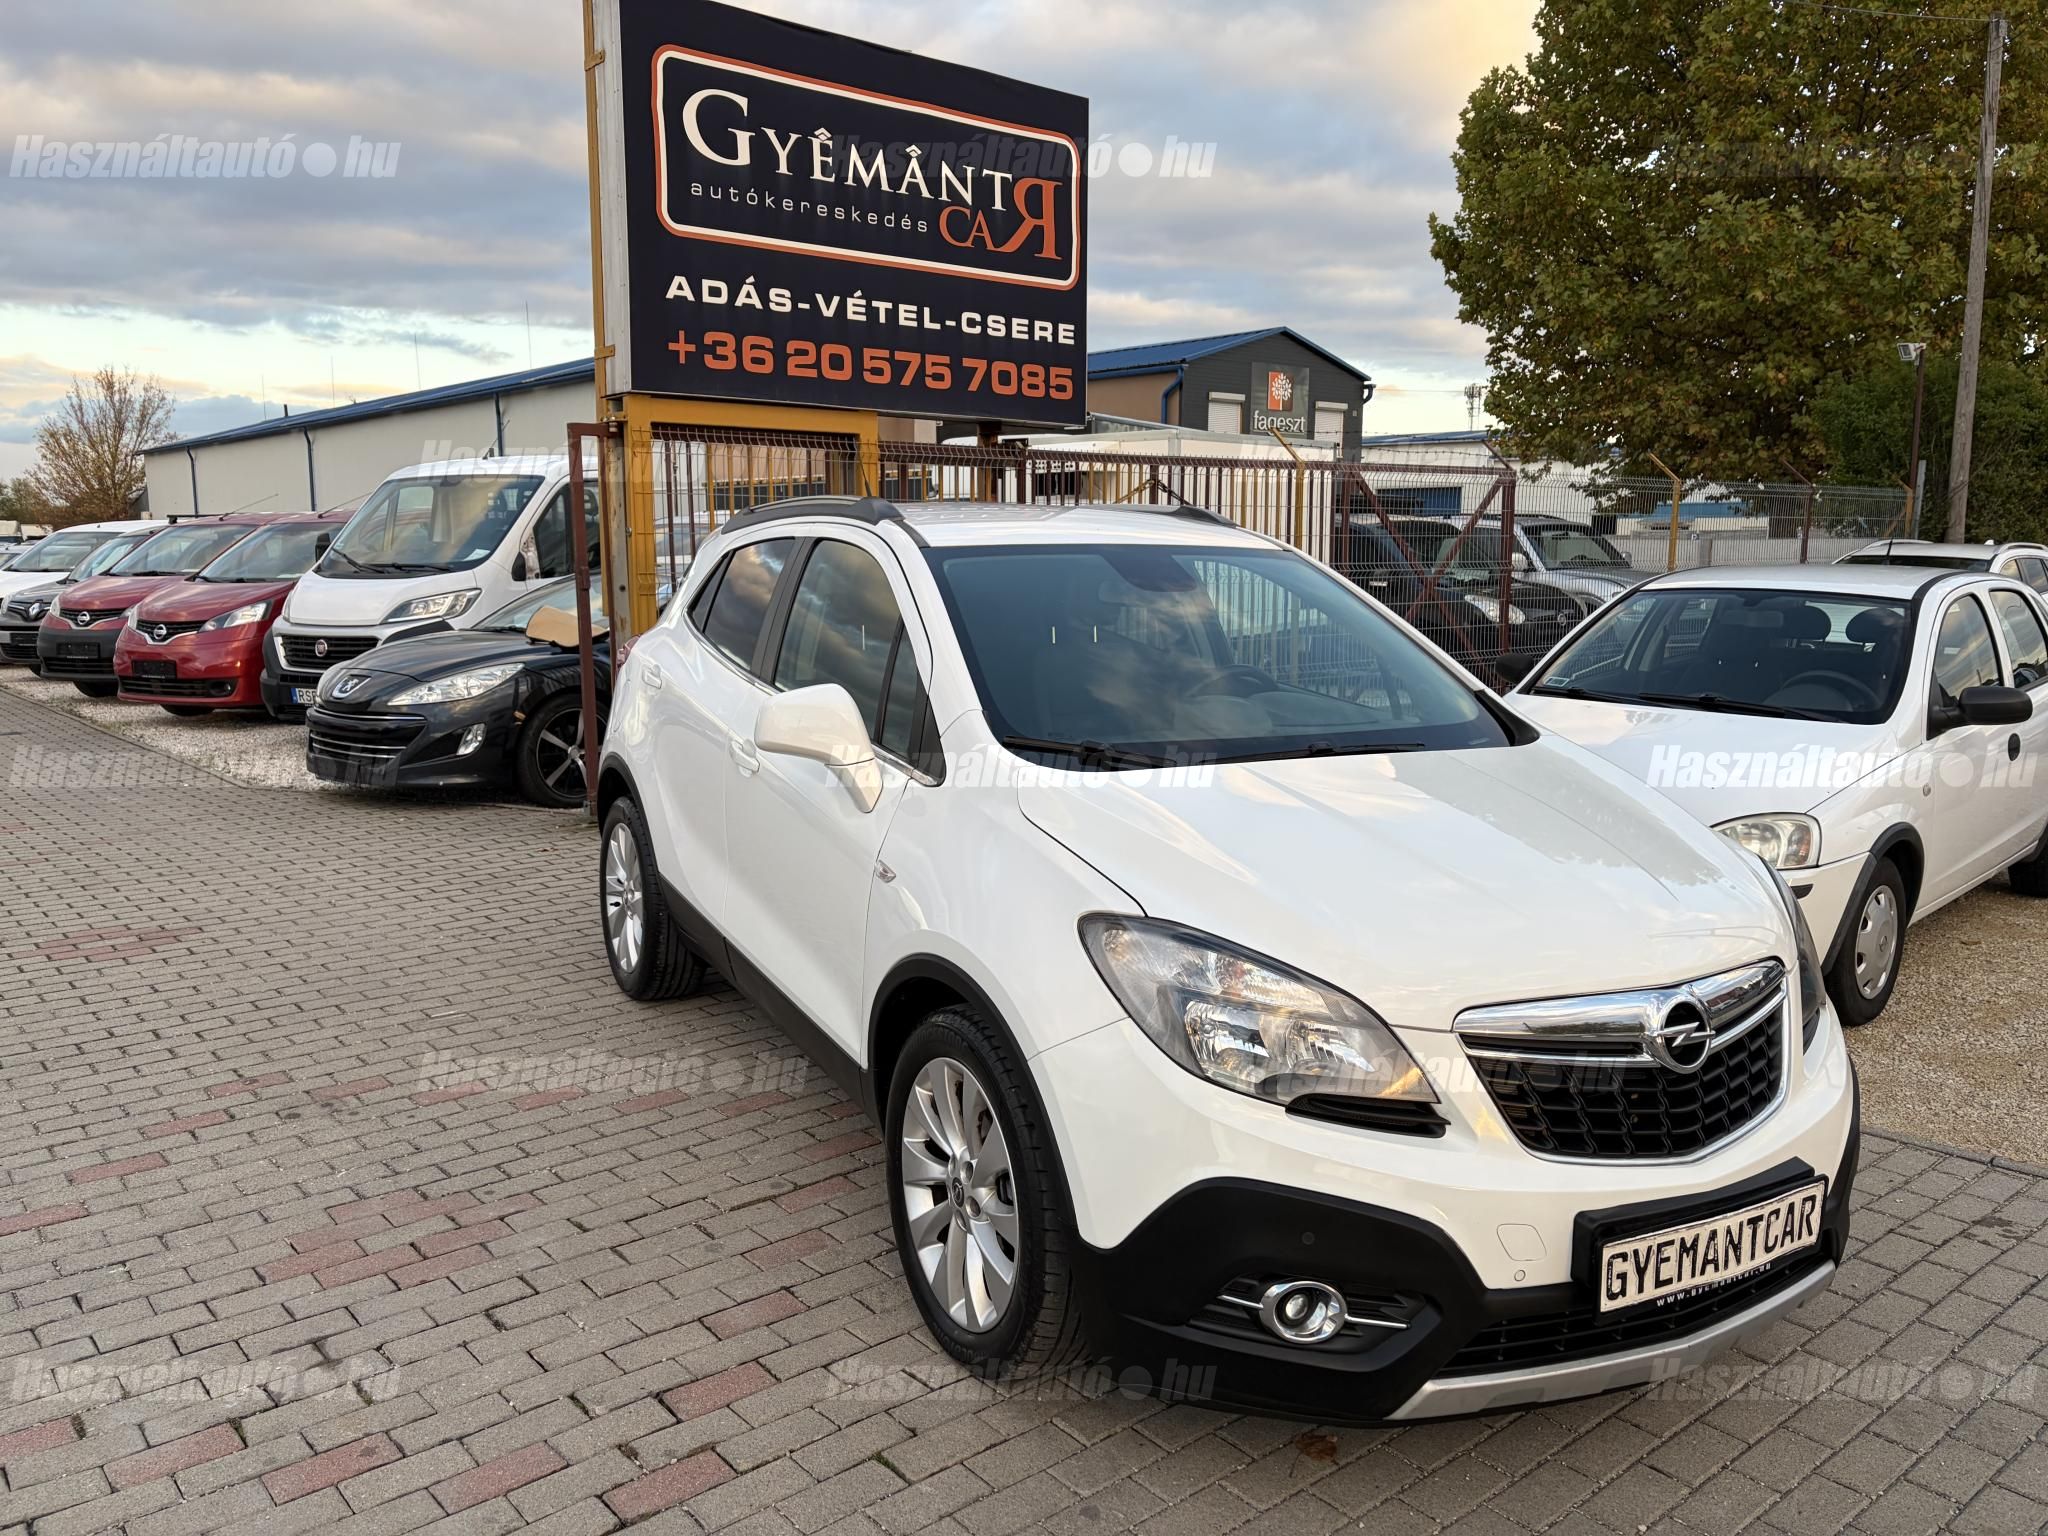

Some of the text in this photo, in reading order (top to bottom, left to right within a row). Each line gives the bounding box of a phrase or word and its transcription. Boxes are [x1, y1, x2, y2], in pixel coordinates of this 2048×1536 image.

[690, 179, 928, 233] autókereskedés
[665, 275, 1076, 346] ADÁS-VÉTEL-CSERE
[668, 330, 1074, 400] +36 20 575 7085
[1253, 410, 1306, 436] fageszt
[1606, 1194, 1817, 1301] GYEMANTCAR
